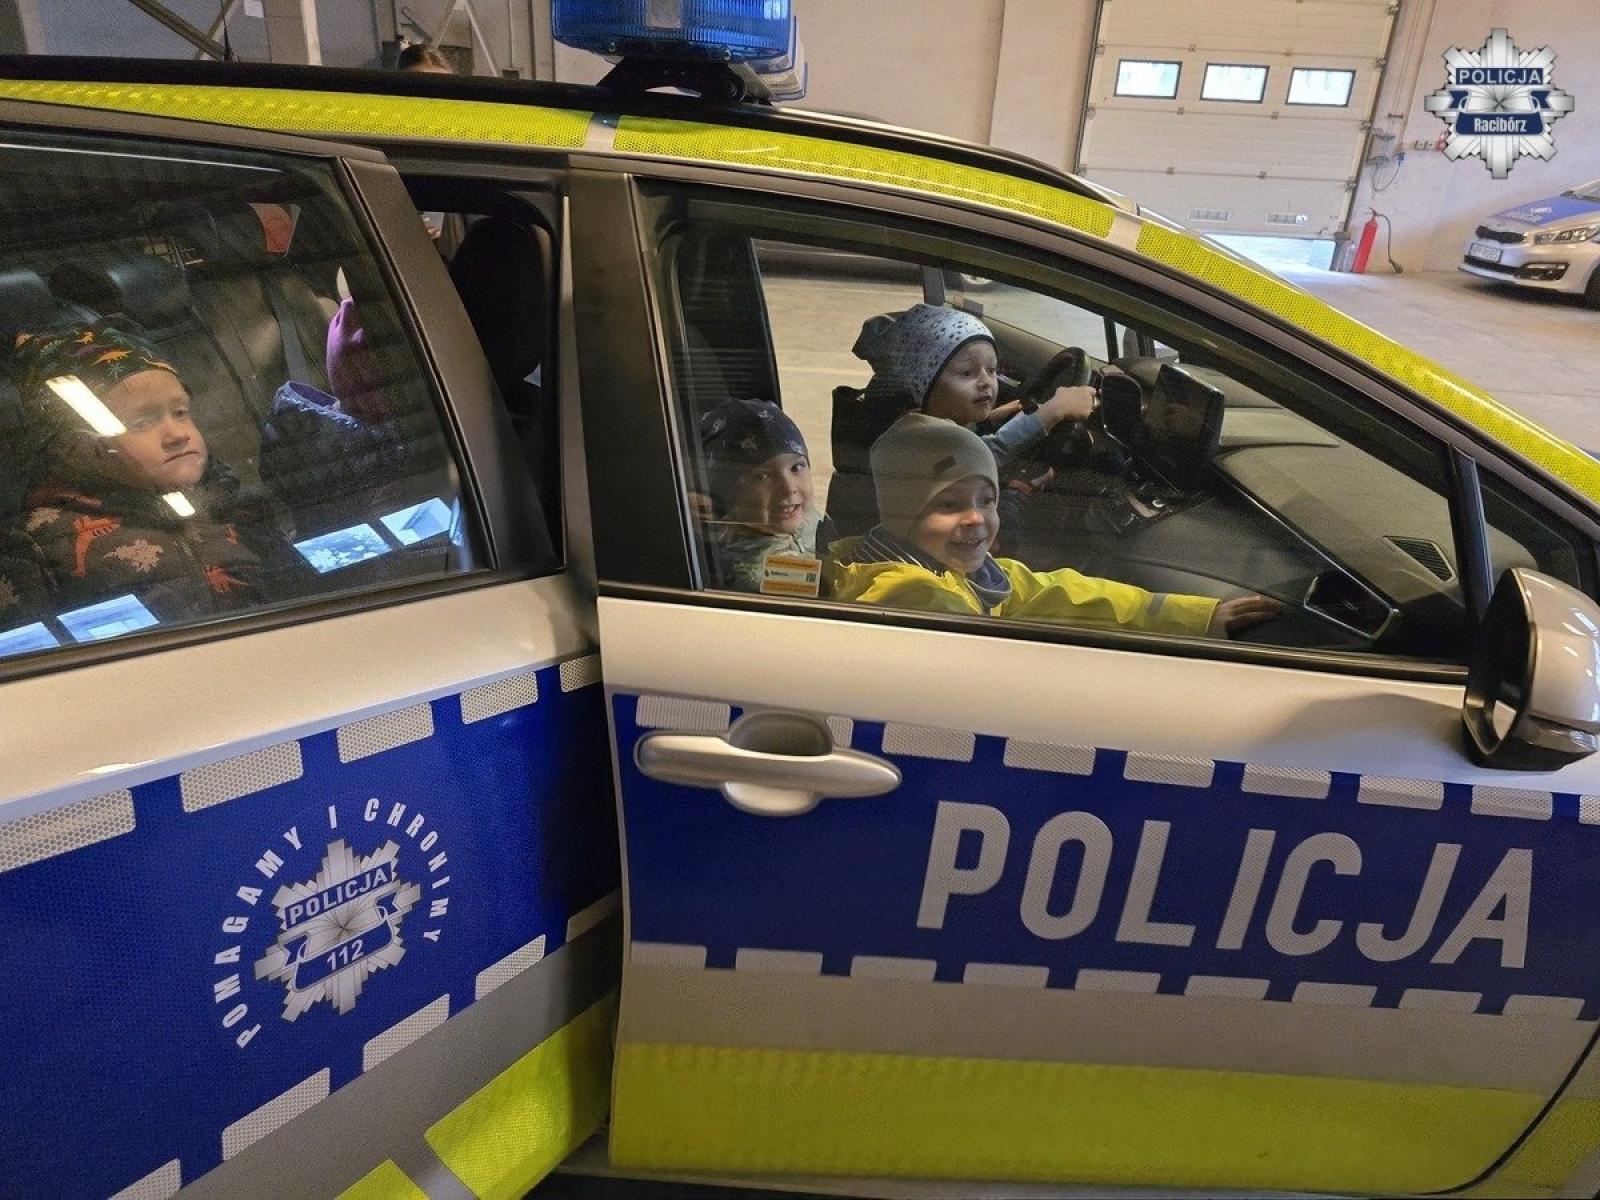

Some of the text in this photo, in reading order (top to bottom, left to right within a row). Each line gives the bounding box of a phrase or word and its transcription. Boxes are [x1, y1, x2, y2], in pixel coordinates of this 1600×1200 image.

[214, 798, 450, 1048] POMAGAMY I CHRONIMY
[289, 866, 390, 925] POLICJA
[916, 800, 1533, 968] POLICJA
[326, 939, 363, 971] 112
